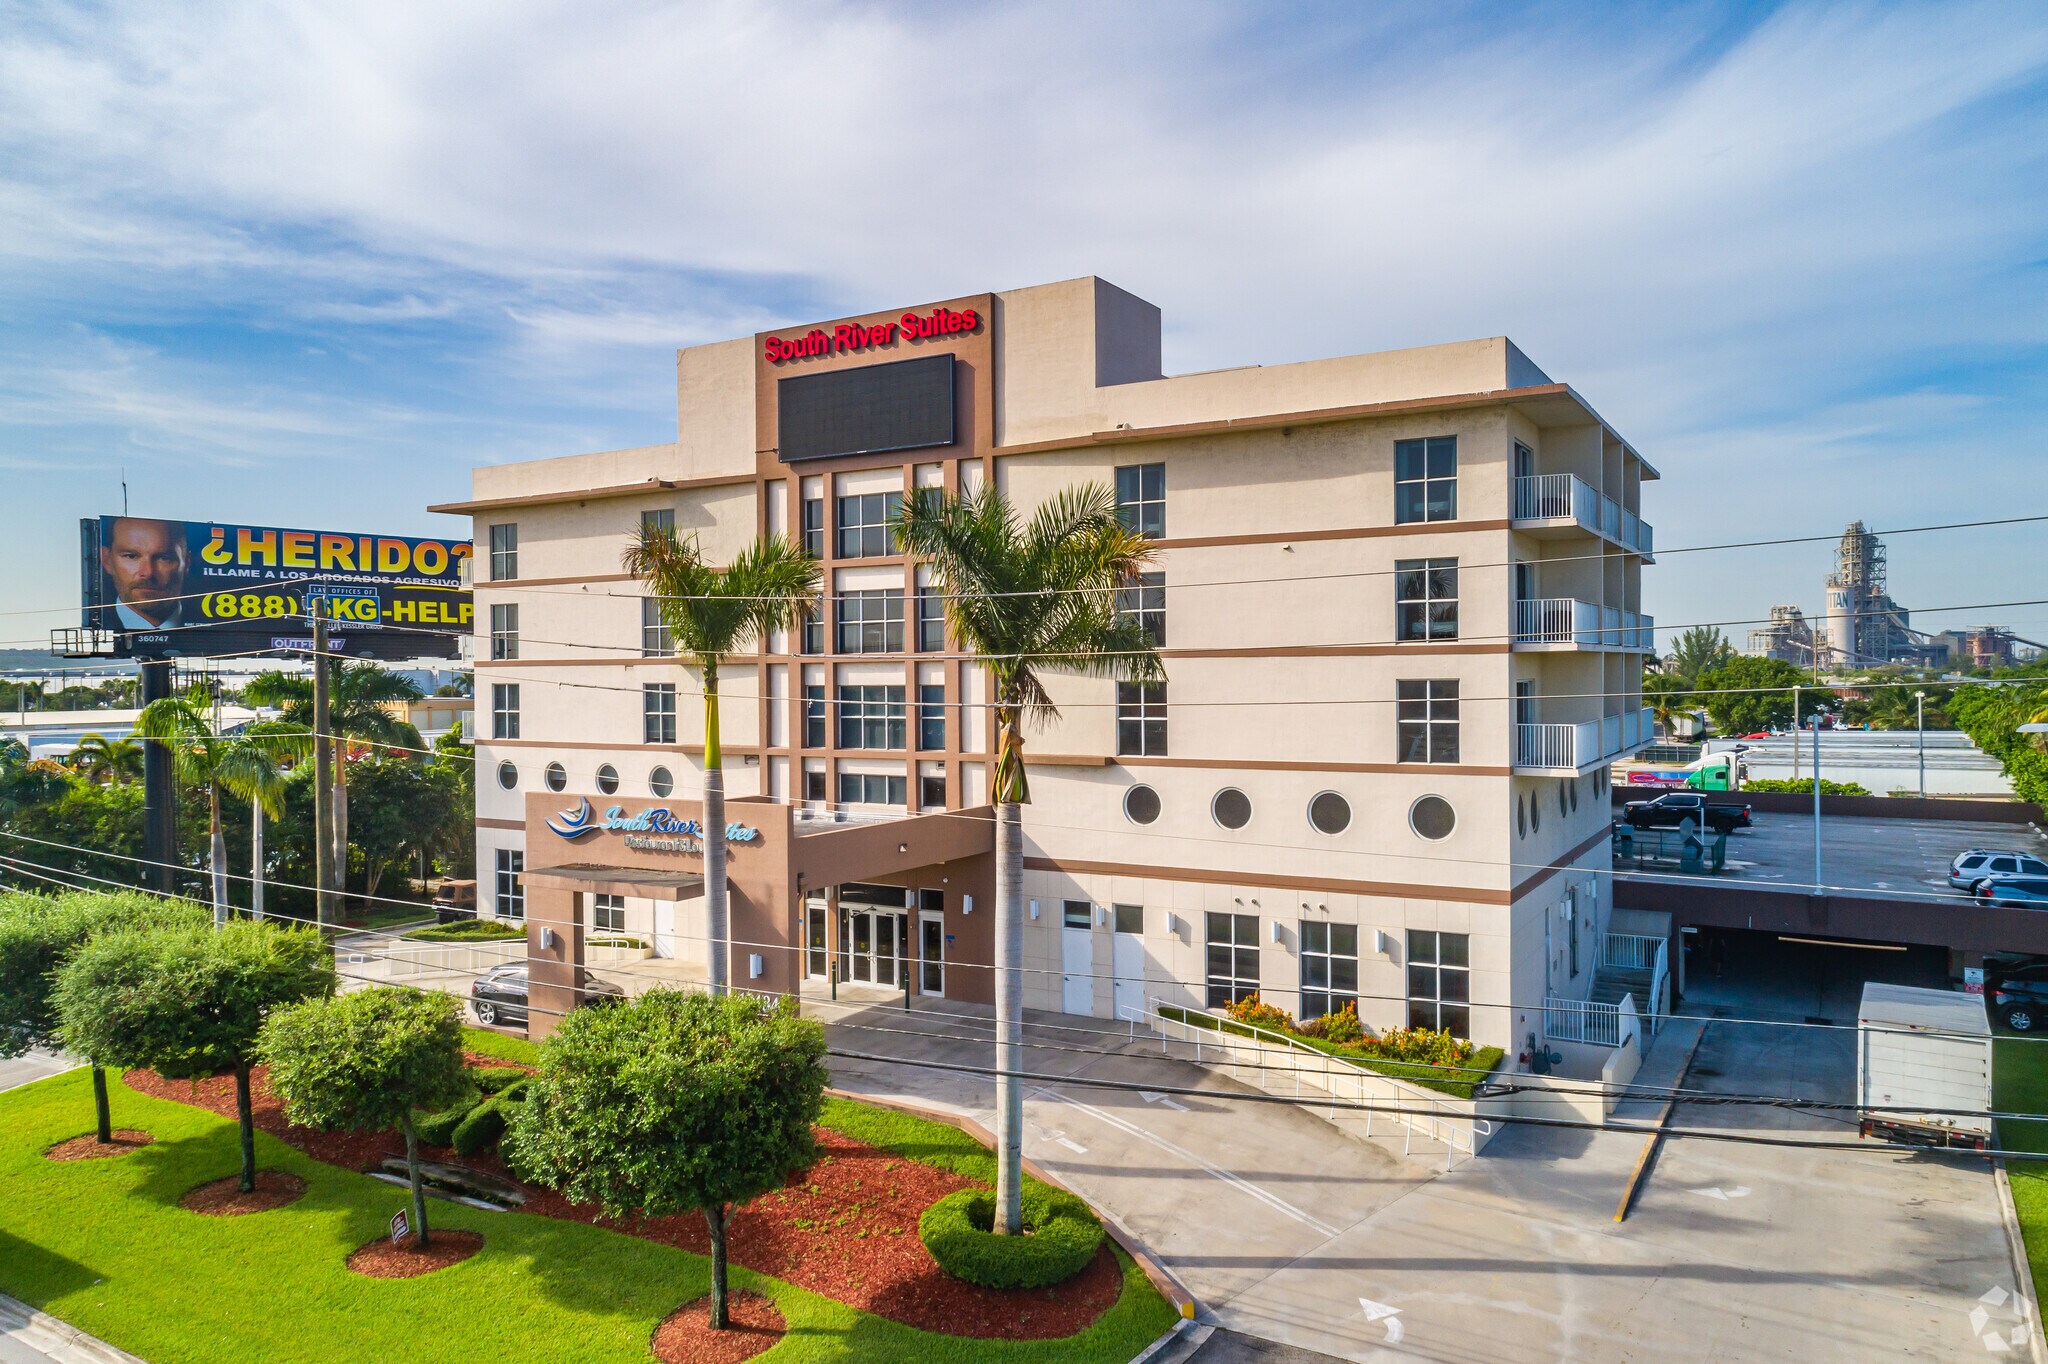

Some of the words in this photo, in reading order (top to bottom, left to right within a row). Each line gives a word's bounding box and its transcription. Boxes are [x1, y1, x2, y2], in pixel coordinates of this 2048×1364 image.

[764, 329, 828, 363] South
[834, 322, 895, 351] River
[900, 308, 977, 341] Suites
[264, 570, 275, 579] A
[280, 571, 308, 579] LOS
[394, 577, 462, 587] AGRESIVO
[201, 593, 298, 619] (888)
[274, 639, 341, 648] OUTFRNT
[599, 806, 652, 831] South
[651, 808, 698, 834] River
